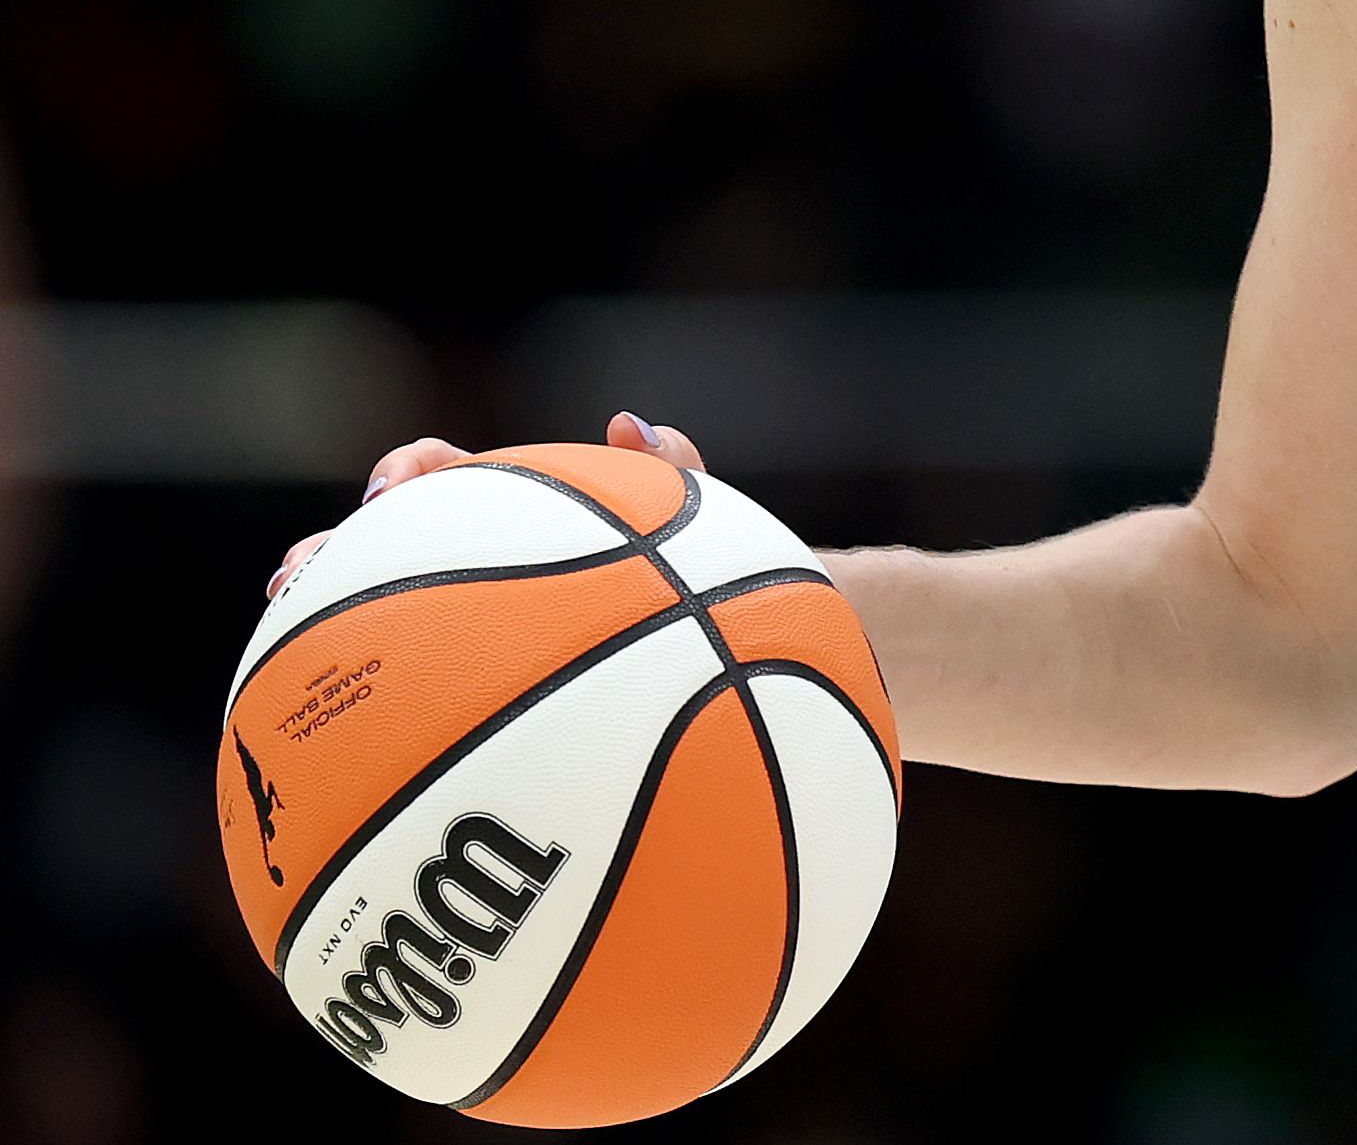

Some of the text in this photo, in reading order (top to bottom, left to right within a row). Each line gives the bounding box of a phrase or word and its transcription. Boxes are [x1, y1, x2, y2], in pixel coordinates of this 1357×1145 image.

[321, 660, 381, 703] GAME
[275, 698, 319, 733] BALL
[290, 685, 372, 743] OFFICIAL
[317, 896, 368, 965] EVO NXT
